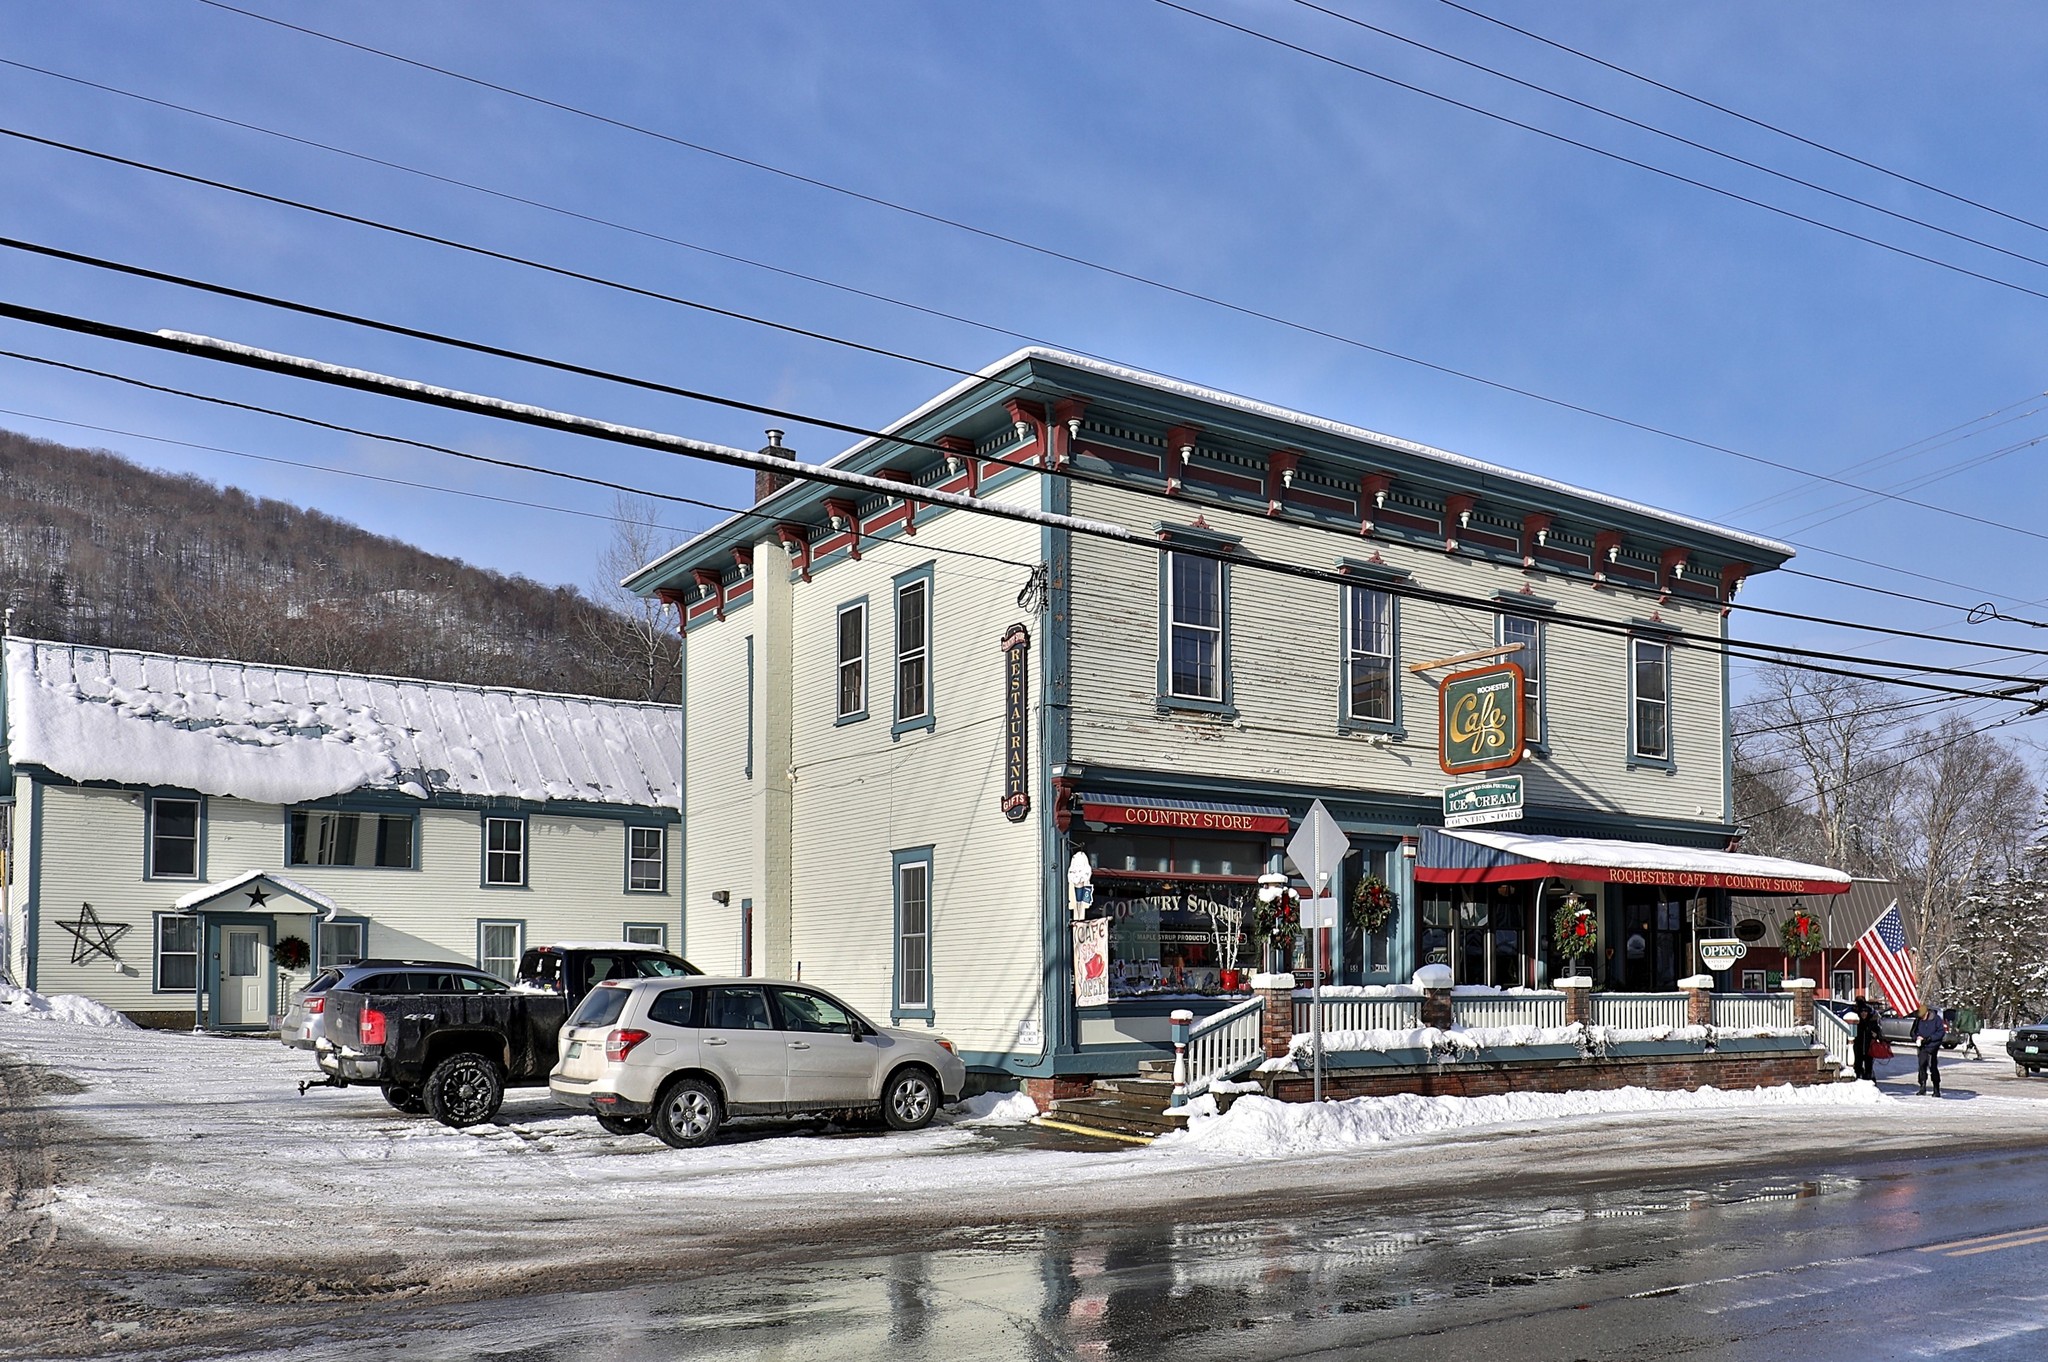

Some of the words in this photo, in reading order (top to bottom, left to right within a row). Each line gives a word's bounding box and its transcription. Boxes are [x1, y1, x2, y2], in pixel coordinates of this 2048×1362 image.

[1477, 682, 1510, 695] ROCHESTER
[1010, 648, 1021, 793] RESTAURANT
[1450, 692, 1507, 754] Cafe
[1003, 794, 1025, 810] GIFTS
[1449, 799, 1468, 812] ICE
[1475, 792, 1517, 808] CREAM
[1125, 808, 1199, 827] COUNTRY
[1203, 813, 1253, 829] STORE
[1446, 815, 1487, 826] COUNTRY
[1609, 869, 1675, 885] ROCHESTER
[1679, 873, 1706, 886] CAFE
[1713, 875, 1720, 887] &
[1725, 875, 1772, 890] COUNTRY
[1773, 879, 1805, 892] STORE
[1102, 895, 1182, 919] COUNTRY
[1137, 933, 1156, 941] MAPLE
[1158, 933, 1176, 941] SYRUP
[1177, 933, 1207, 941] PRODUCTS
[1702, 945, 1736, 957] OPEN
